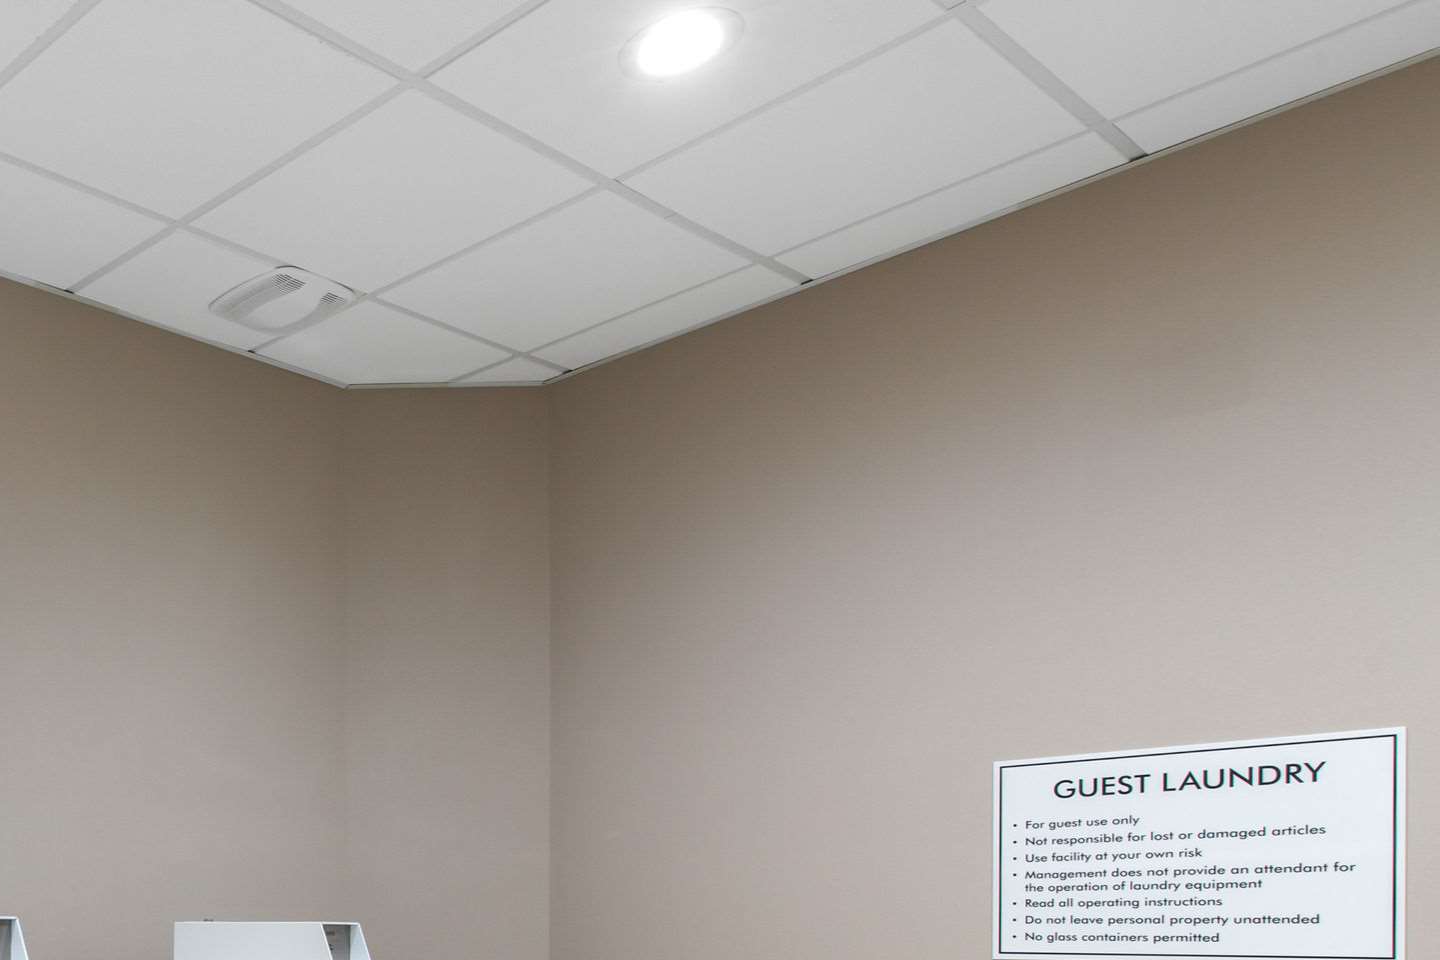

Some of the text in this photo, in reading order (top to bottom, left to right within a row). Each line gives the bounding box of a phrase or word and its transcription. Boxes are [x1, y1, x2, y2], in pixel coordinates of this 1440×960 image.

[1054, 761, 1327, 799] GUEST LAUNDRY
[1025, 815, 1140, 831] For guest use only
[1025, 824, 1327, 847] Not responsible for lost or damaged articles
[1025, 847, 1203, 863] Use facility at your own risk
[1025, 861, 1357, 881] Management does not provide an attendant for
[1025, 879, 1263, 894] the operation of laundry equipment
[1025, 896, 1223, 910] Read all operating instructions
[1025, 913, 1321, 927] Do not leave personal property unattended
[1025, 932, 1220, 944] No glass containers permitted
